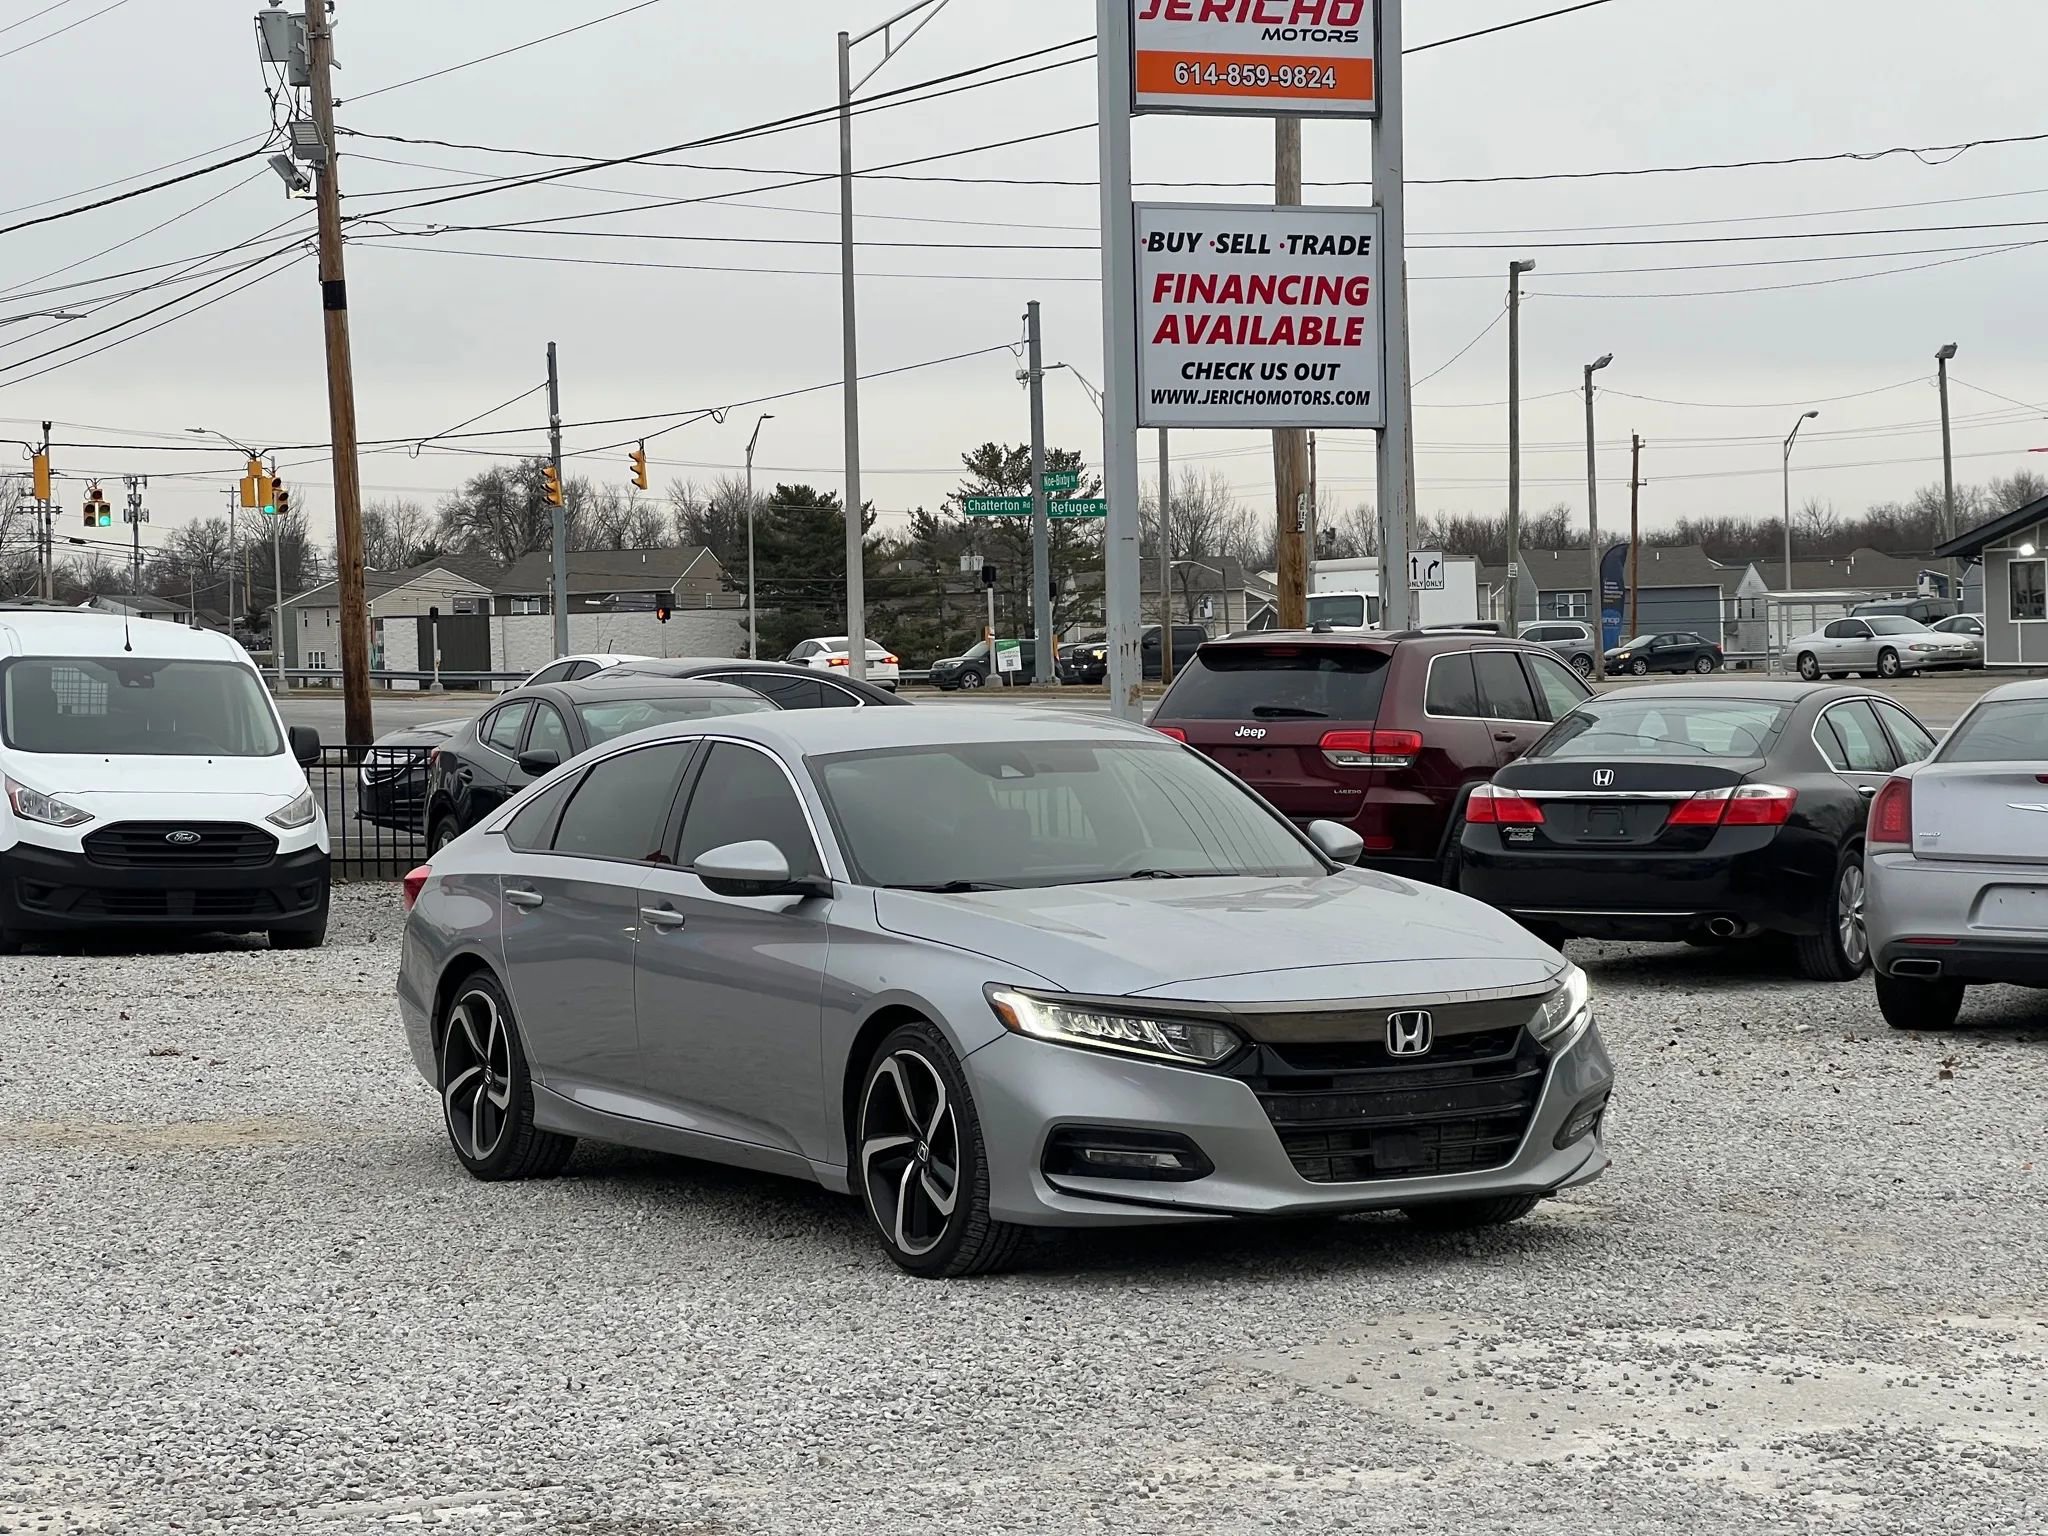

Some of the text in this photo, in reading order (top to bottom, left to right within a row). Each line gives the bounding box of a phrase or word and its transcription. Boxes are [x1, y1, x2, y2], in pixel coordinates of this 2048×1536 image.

[1139, 0, 1365, 26] JERICHO
[1261, 27, 1359, 43] MOTORS
[1174, 61, 1336, 89] 614-859-9824
[1152, 273, 1370, 306] FINANCING
[1152, 314, 1365, 346] AVAILABLE
[1181, 361, 1341, 381] CHECK US OUT
[1151, 388, 1371, 406] WWW.JERICHOMOTORS.COM
[968, 499, 1031, 512] Chatterton Rd
[1051, 501, 1096, 516] Refugee
[1234, 725, 1267, 740] Jeep
